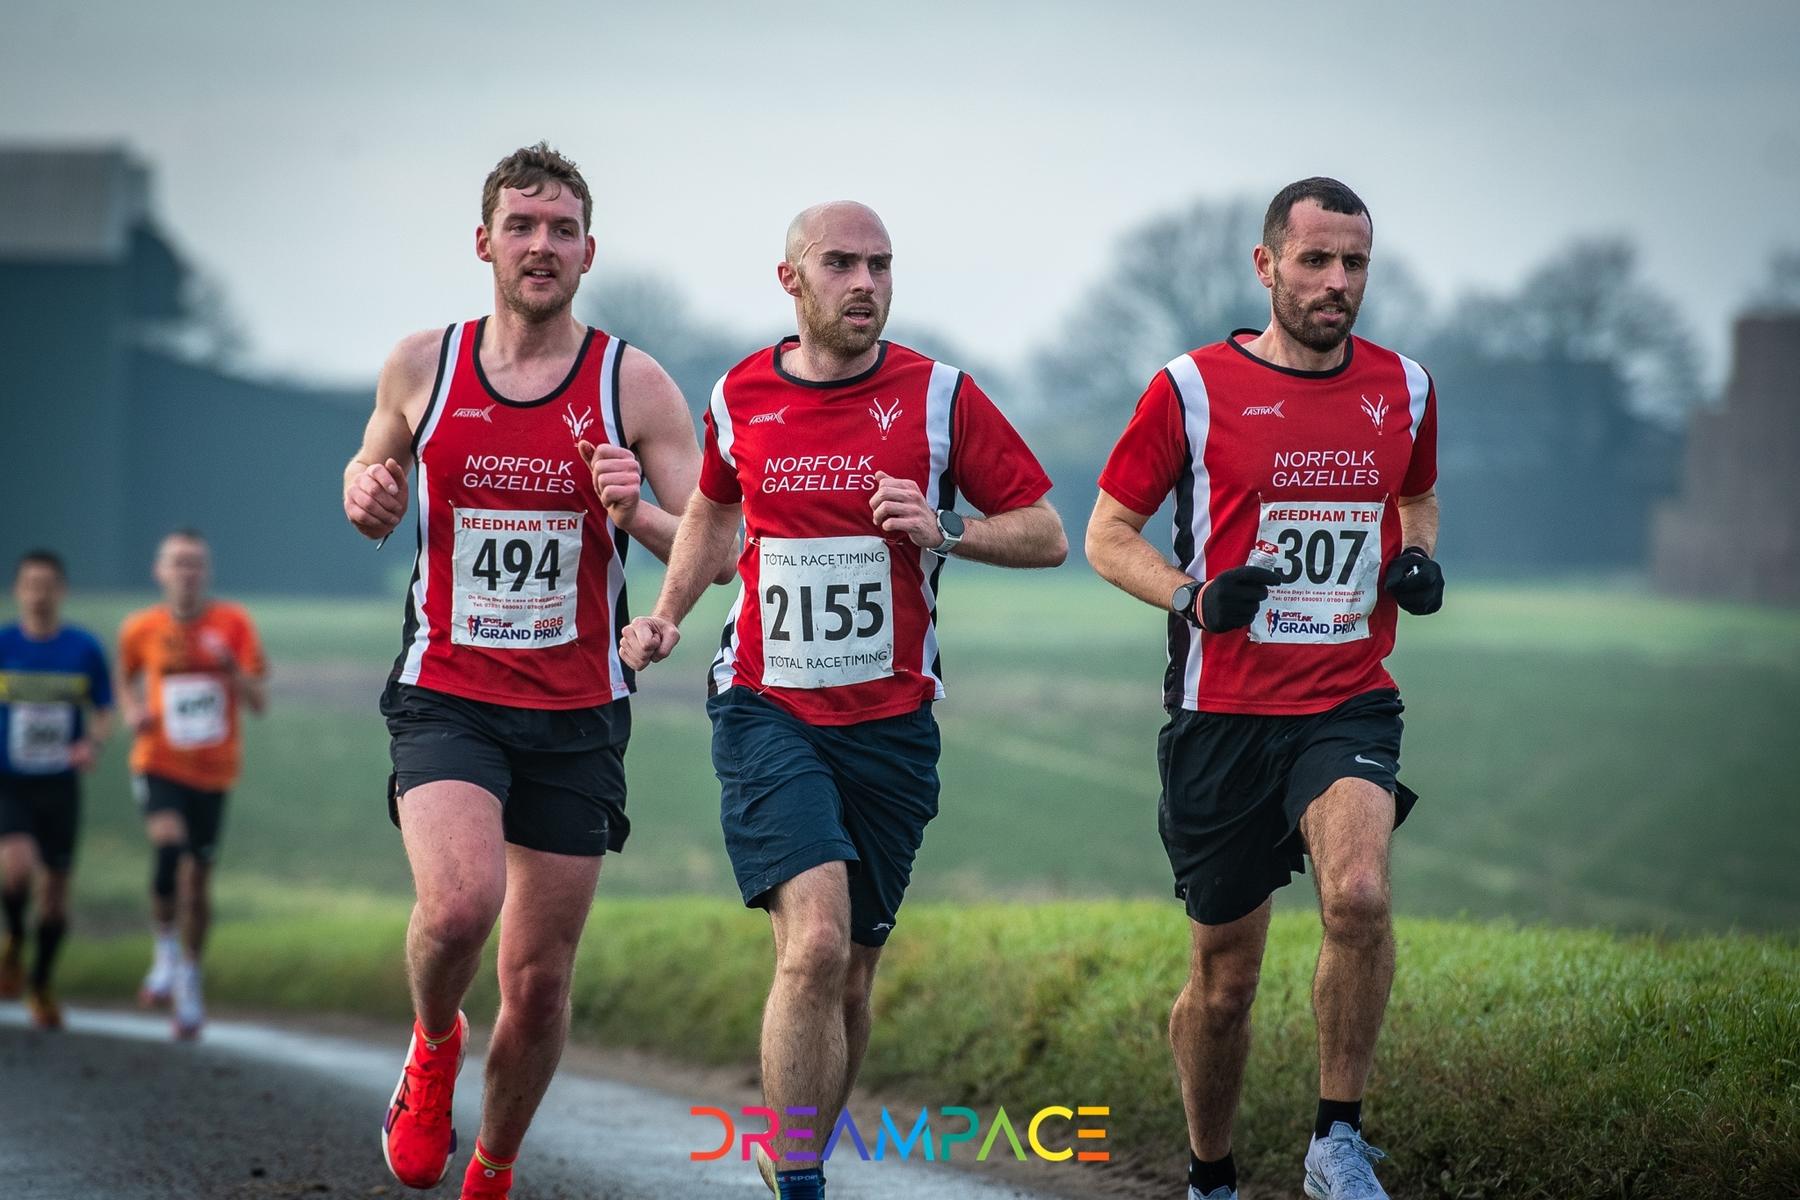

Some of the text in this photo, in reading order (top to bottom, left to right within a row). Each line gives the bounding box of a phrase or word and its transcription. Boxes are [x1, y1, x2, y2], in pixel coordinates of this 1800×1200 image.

[749, 405, 790, 425] FASTRAX
[1242, 400, 1285, 418] FASTRAX
[465, 455, 573, 476] NORFOLK
[764, 455, 874, 474] NORFOLK
[1274, 450, 1375, 468] NORFOLK
[463, 473, 575, 494] GAZELLES
[762, 474, 876, 494] GAZELLES
[1272, 470, 1379, 487] GAZELLES
[461, 516, 578, 532] REEDHAM TEN
[1268, 509, 1378, 522] REEDHAM TEN
[472, 538, 561, 592] 494
[764, 552, 885, 566] TOTAL RACE TIMING
[1273, 528, 1368, 585] 307
[766, 582, 884, 641] 2155
[534, 616, 564, 629] 2026
[1280, 620, 1356, 635] GRAND PRIX
[480, 626, 562, 640] GRAND PRIX
[769, 651, 887, 669] TOTAL RACE TIMING
